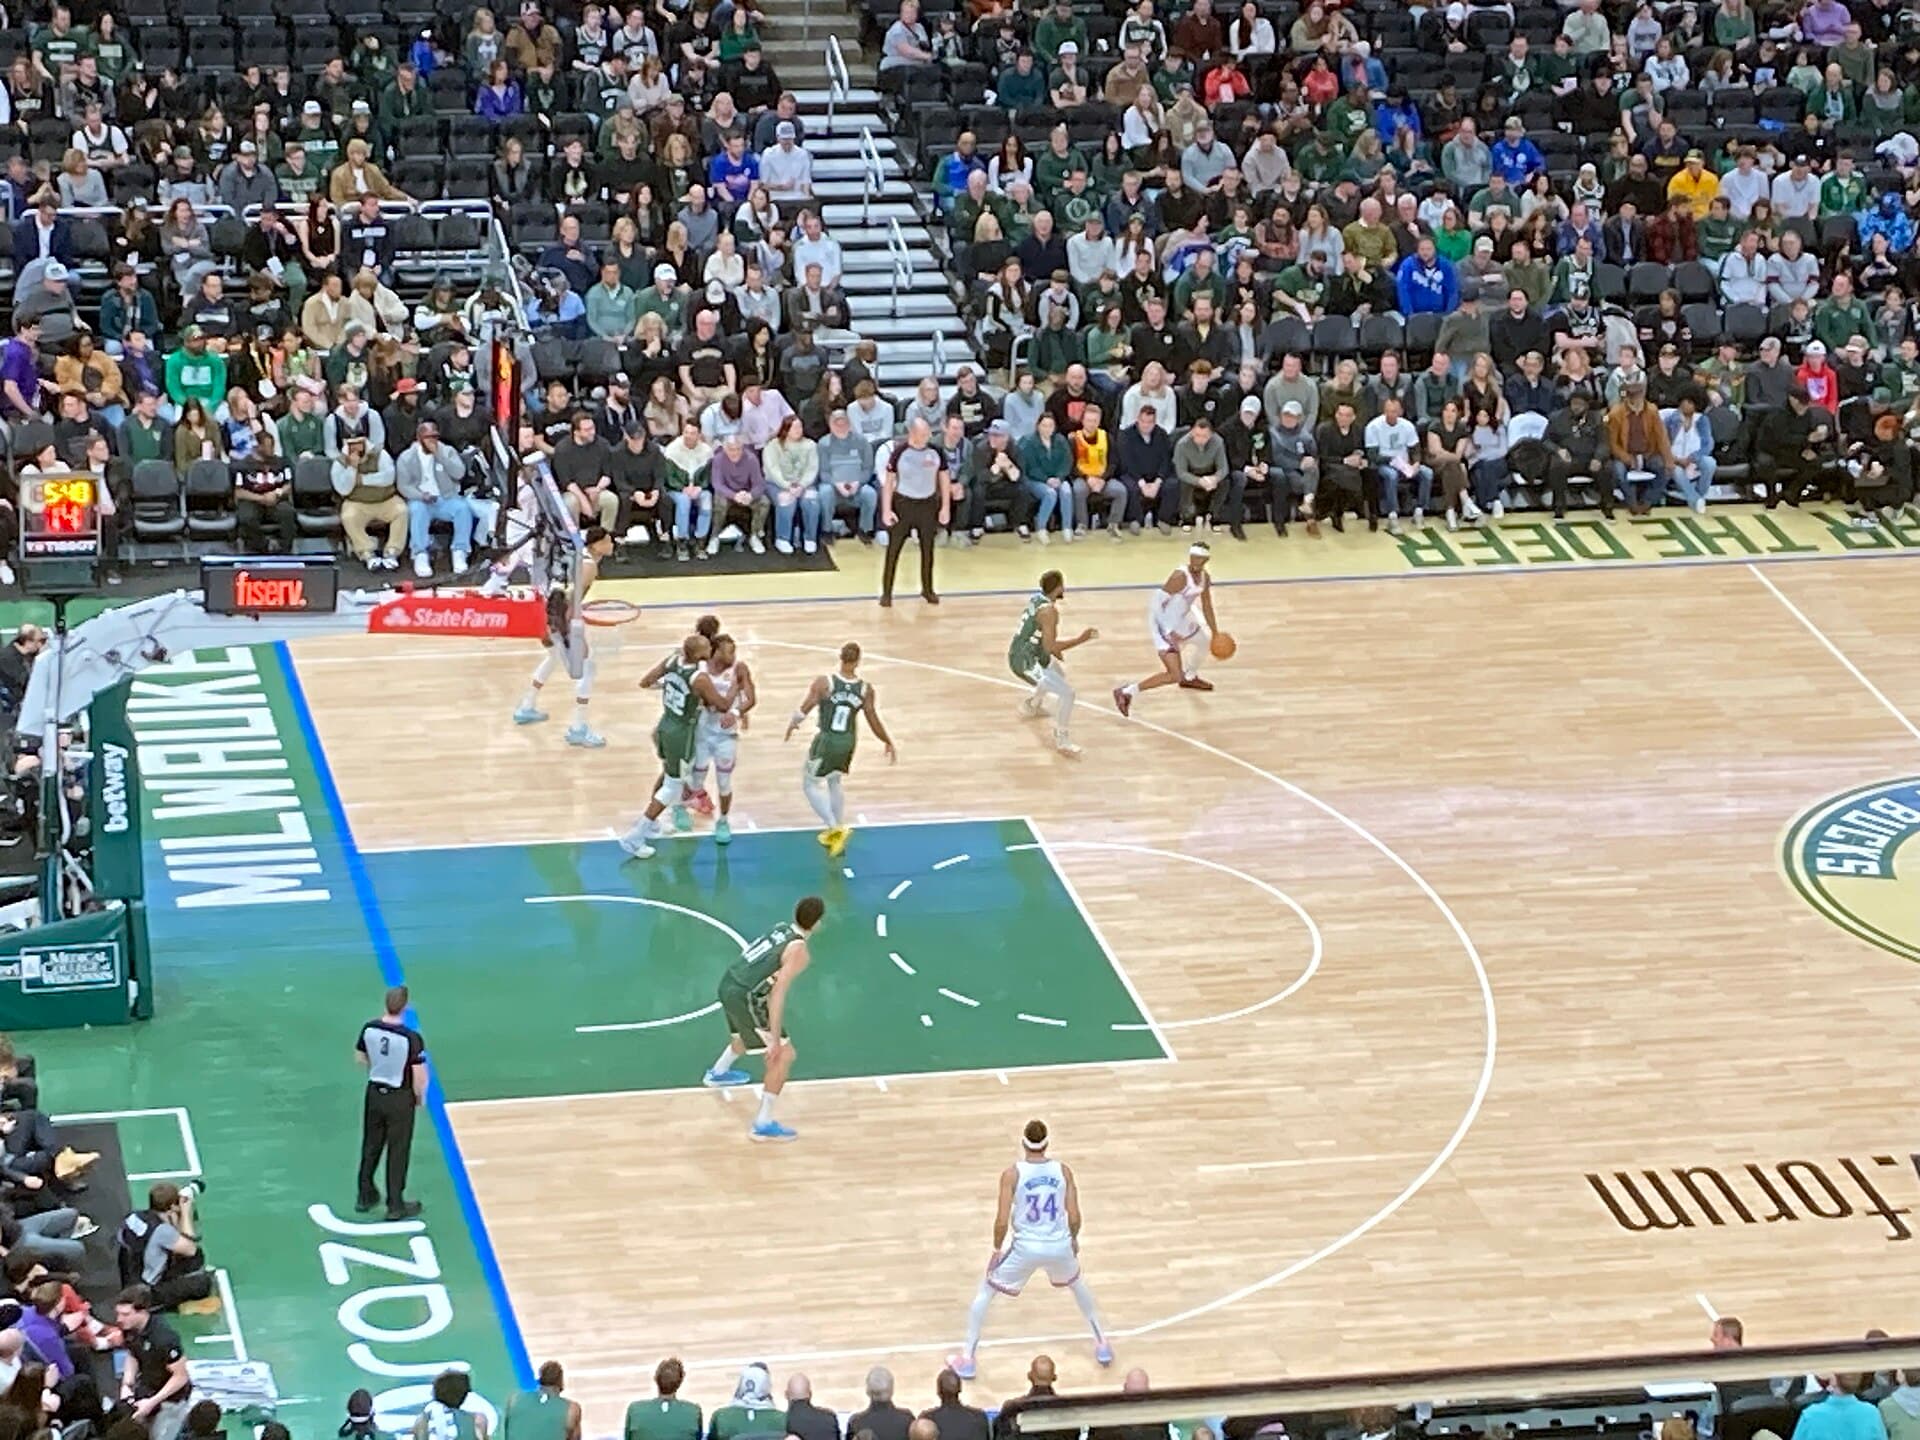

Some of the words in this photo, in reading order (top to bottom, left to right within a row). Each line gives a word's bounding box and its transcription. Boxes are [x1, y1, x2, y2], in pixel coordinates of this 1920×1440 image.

[1384, 519, 1635, 567] DEER
[1629, 514, 1821, 558] THE
[102, 742, 129, 833] betway
[127, 645, 331, 909] MILWAUKE
[1815, 797, 1920, 876] BUCKS
[1025, 1192, 1059, 1223] 34
[1584, 1153, 1920, 1241] .forum
